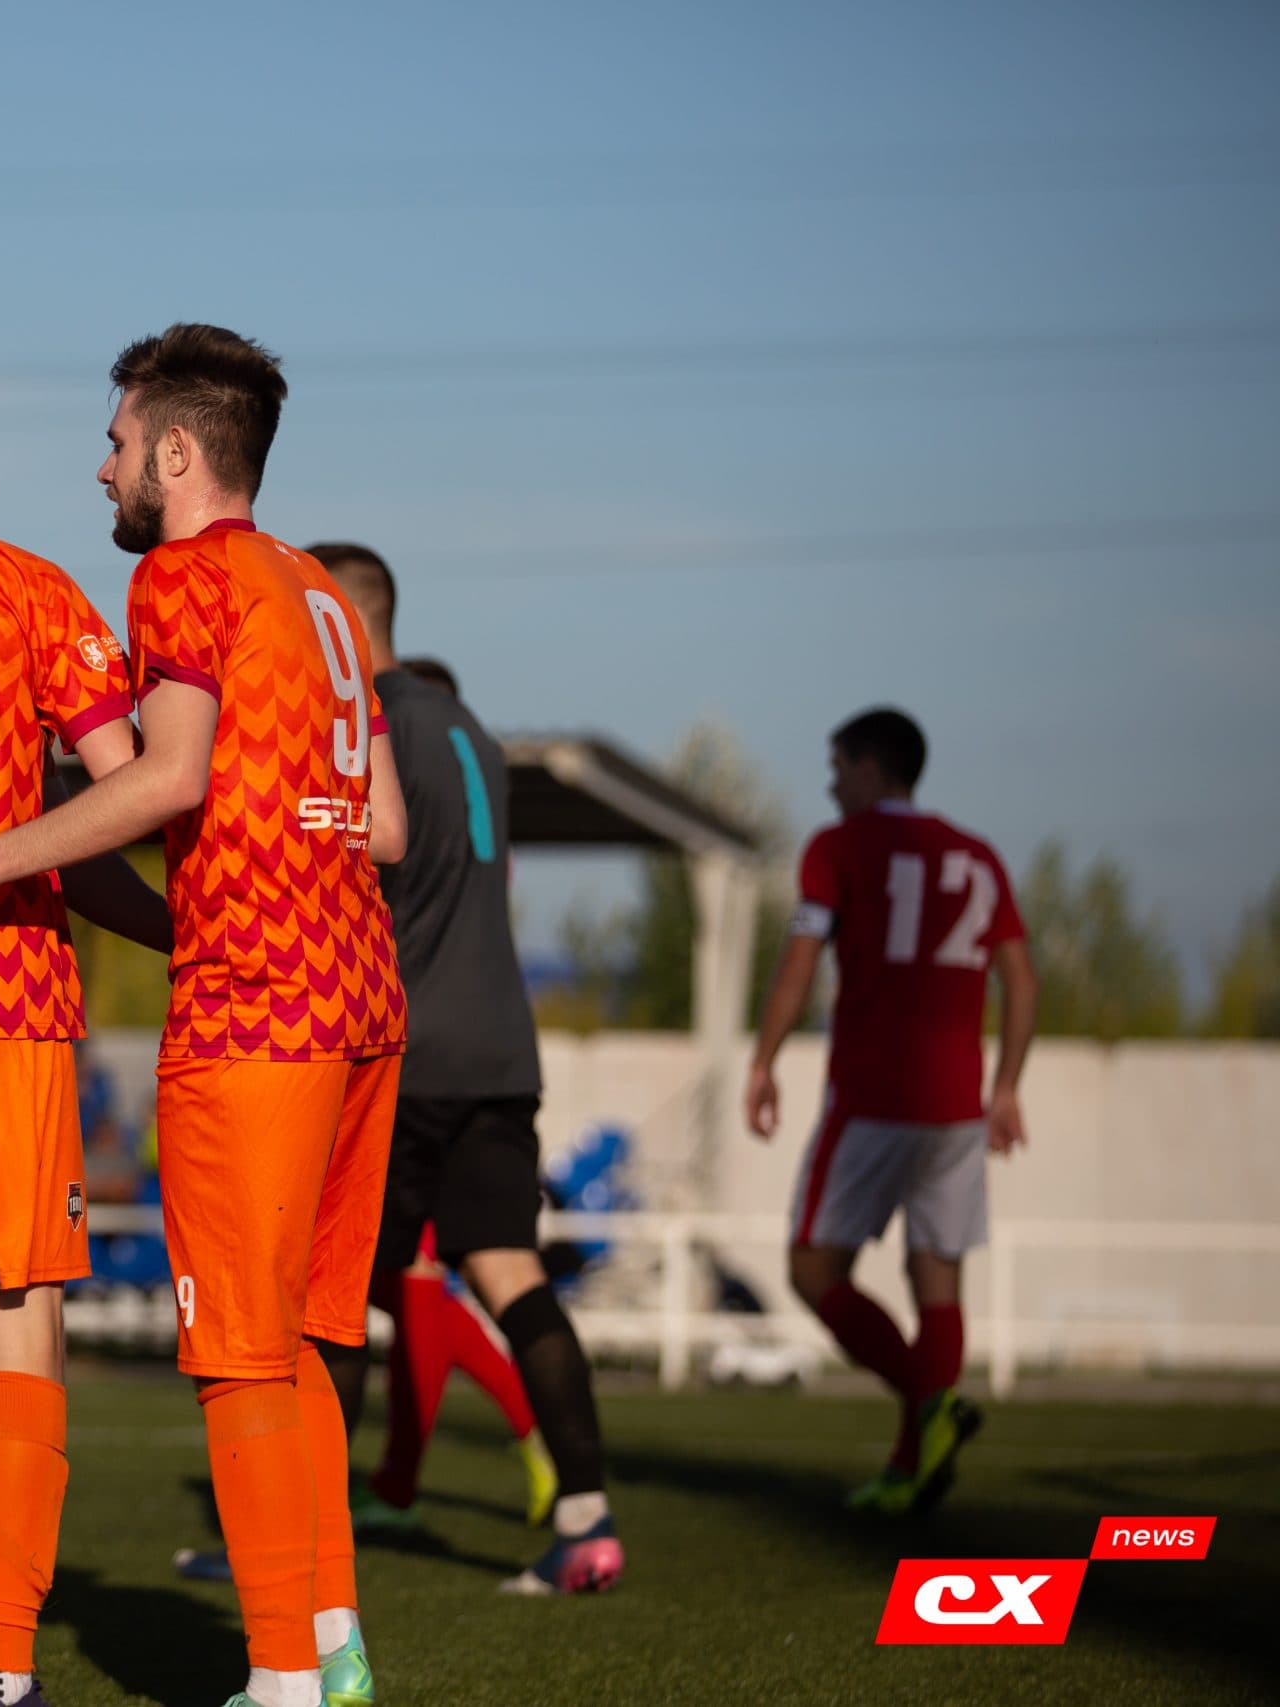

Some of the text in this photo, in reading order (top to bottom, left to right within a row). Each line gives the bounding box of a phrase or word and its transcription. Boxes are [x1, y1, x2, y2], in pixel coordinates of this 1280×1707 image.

[305, 589, 371, 777] 9
[884, 850, 999, 969] 12
[178, 1275, 195, 1328] 9
